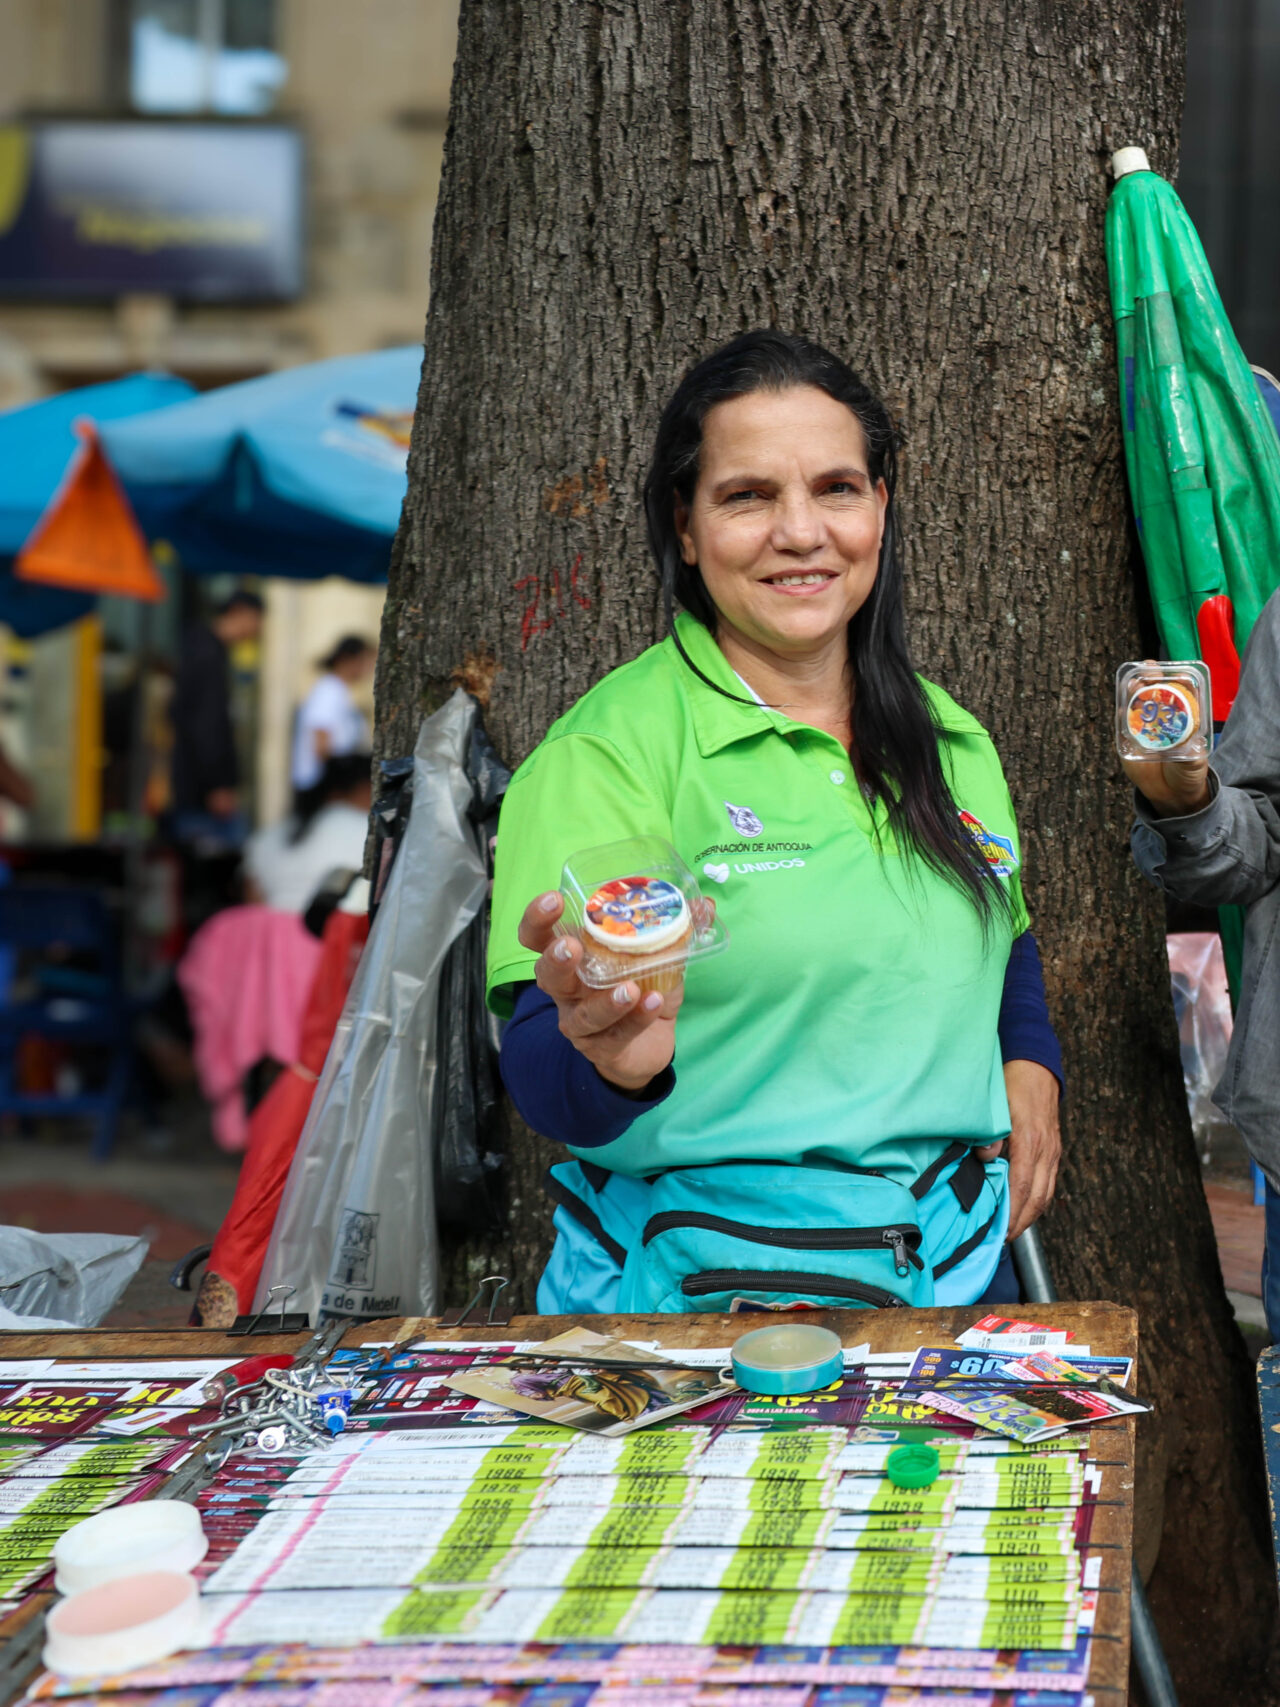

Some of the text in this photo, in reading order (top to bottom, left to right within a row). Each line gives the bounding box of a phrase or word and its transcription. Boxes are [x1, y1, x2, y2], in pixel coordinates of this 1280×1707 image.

[752, 844, 764, 852] DE
[766, 842, 813, 852] ANTIOQUIA
[734, 858, 806, 874] UNIDOS
[334, 1294, 354, 1311] de
